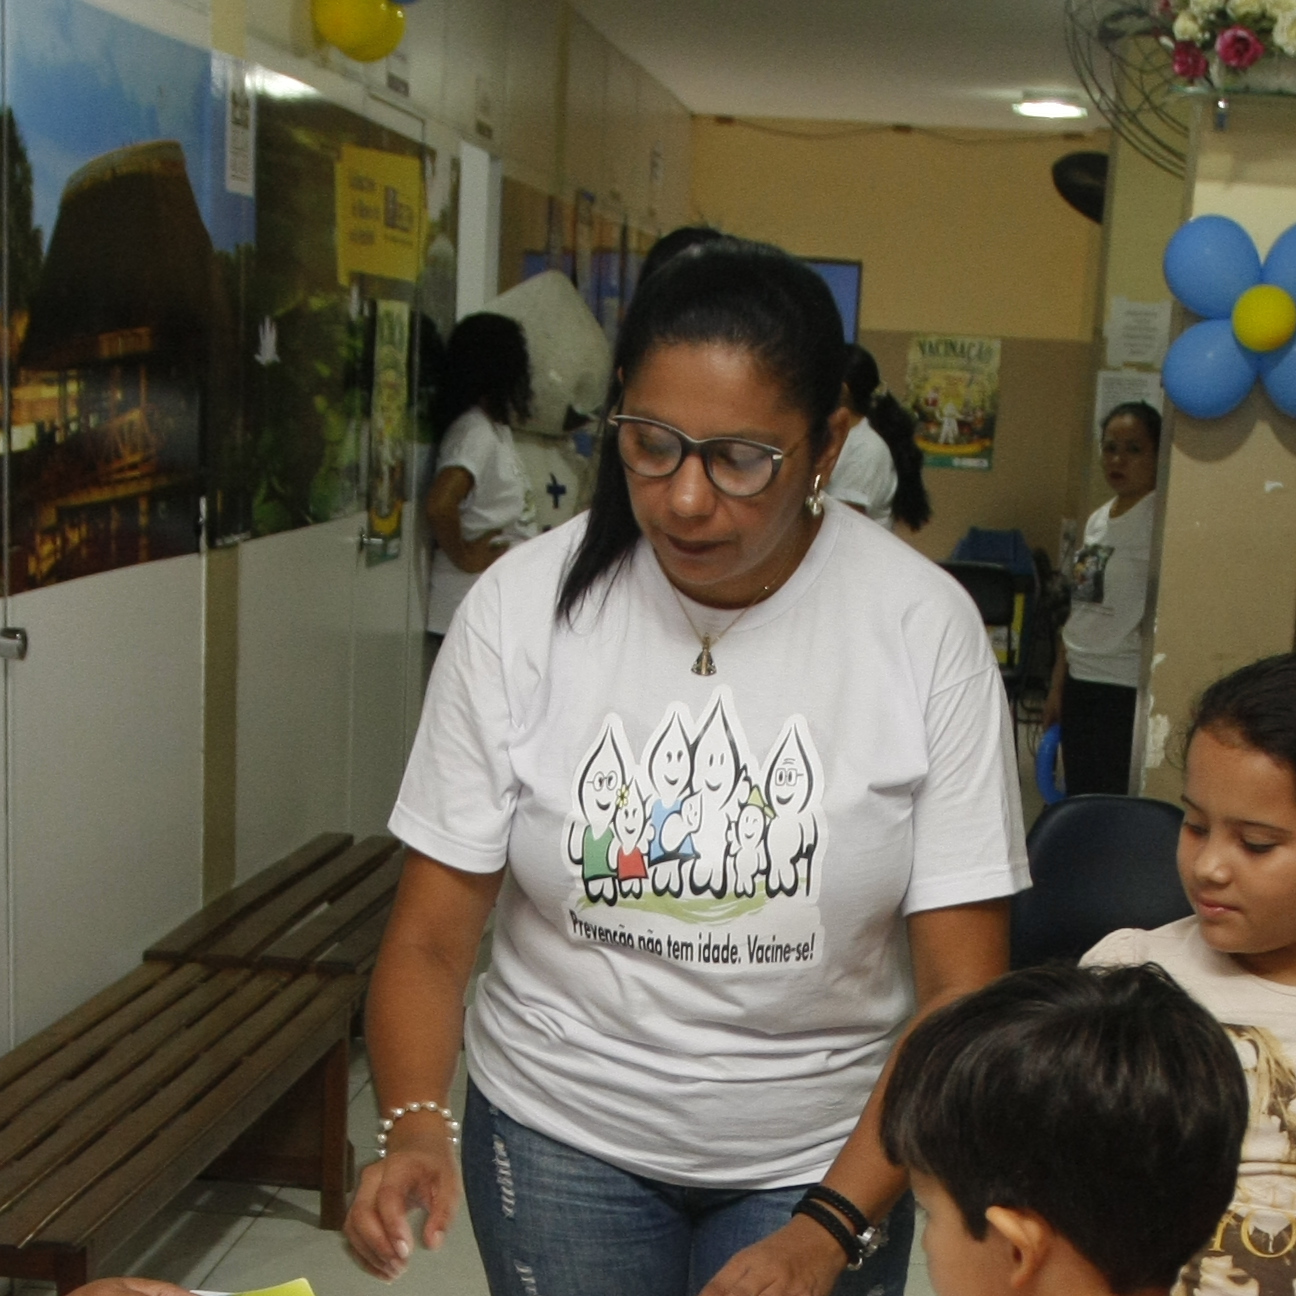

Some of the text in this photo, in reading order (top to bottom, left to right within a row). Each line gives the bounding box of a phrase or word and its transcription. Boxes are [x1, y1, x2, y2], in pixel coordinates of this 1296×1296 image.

[638, 928, 663, 956] não
[667, 934, 694, 962] tem
[698, 931, 742, 964] idade.
[746, 932, 816, 964] Vacine-se!
